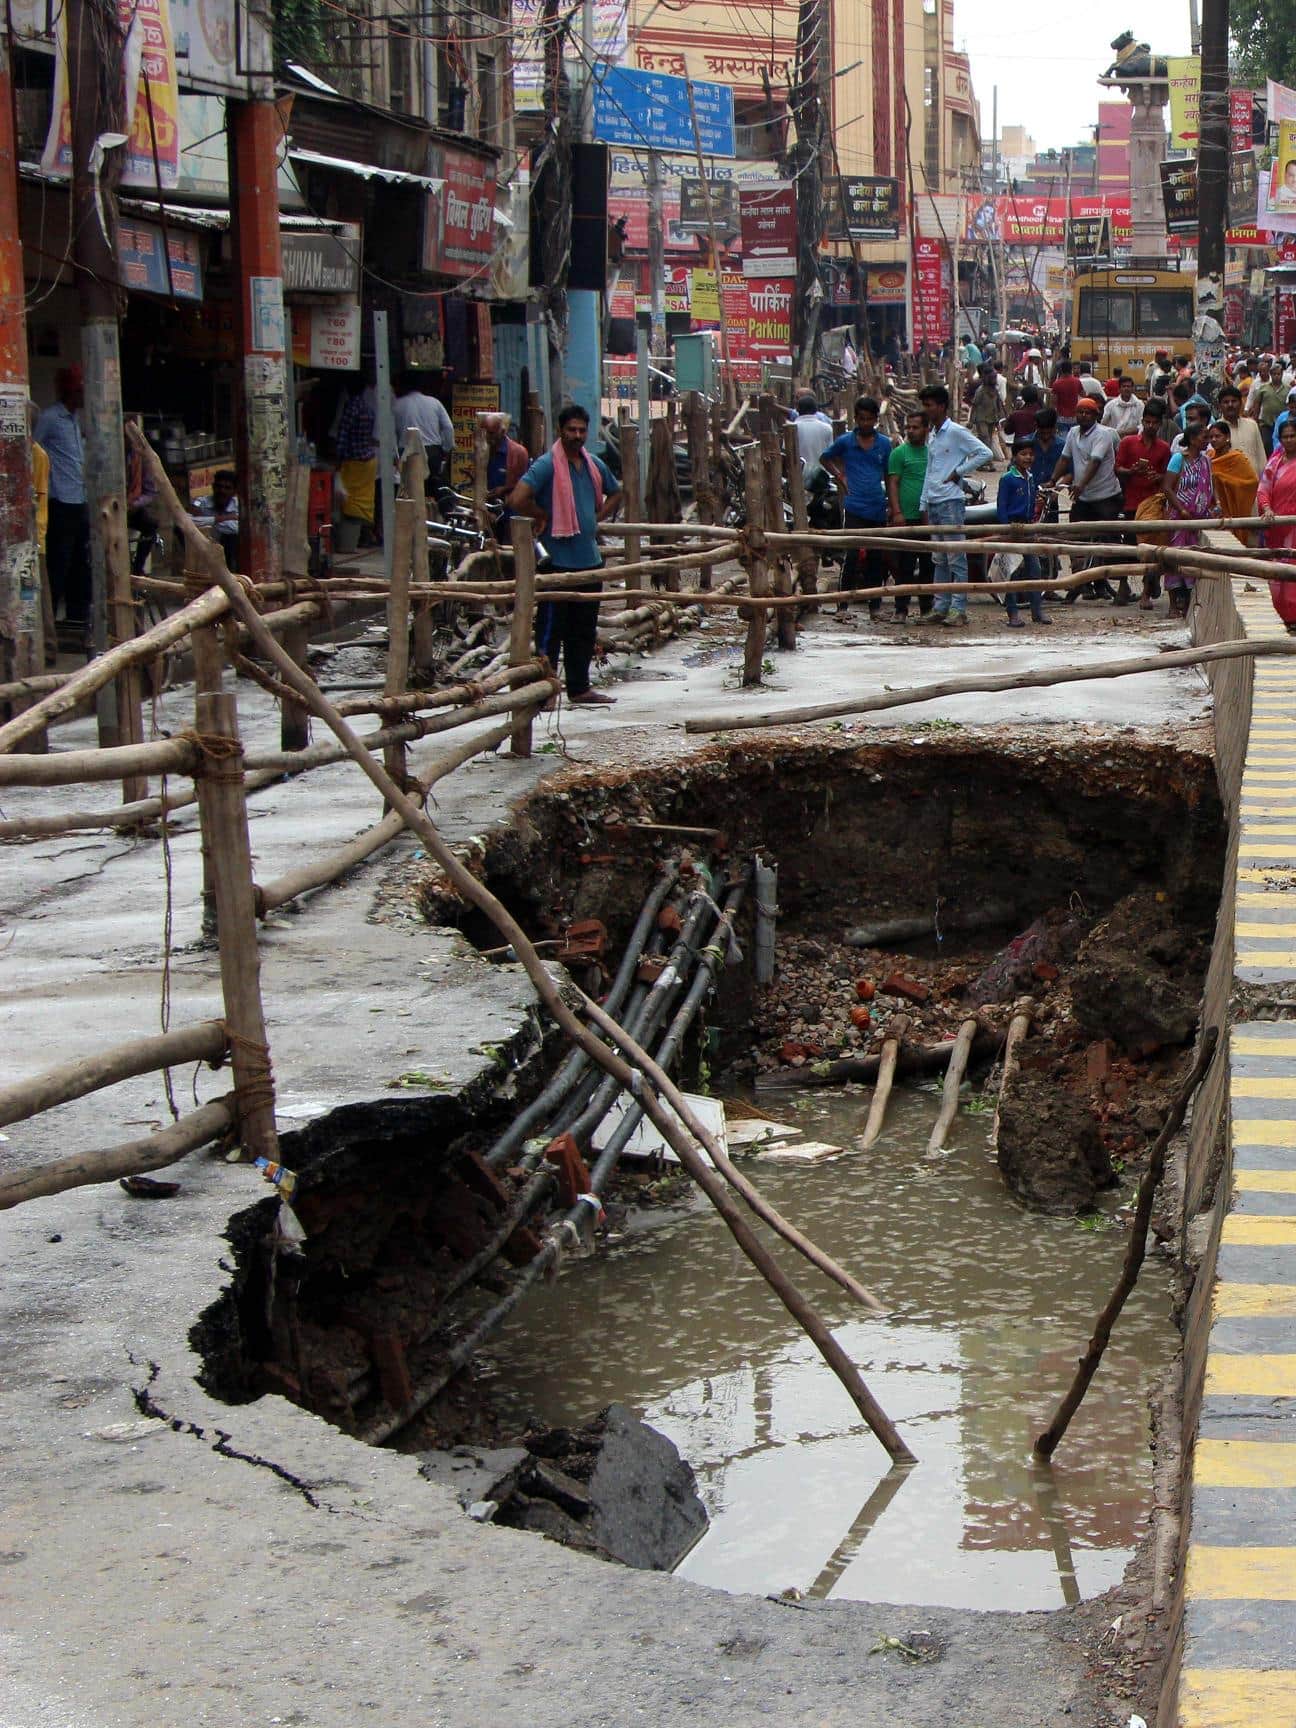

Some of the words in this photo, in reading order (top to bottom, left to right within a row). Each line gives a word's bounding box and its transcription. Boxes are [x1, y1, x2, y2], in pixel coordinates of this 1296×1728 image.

[853, 200, 870, 211] कला
[282, 250, 322, 288] SHIVAM
[748, 318, 790, 344] Parking
